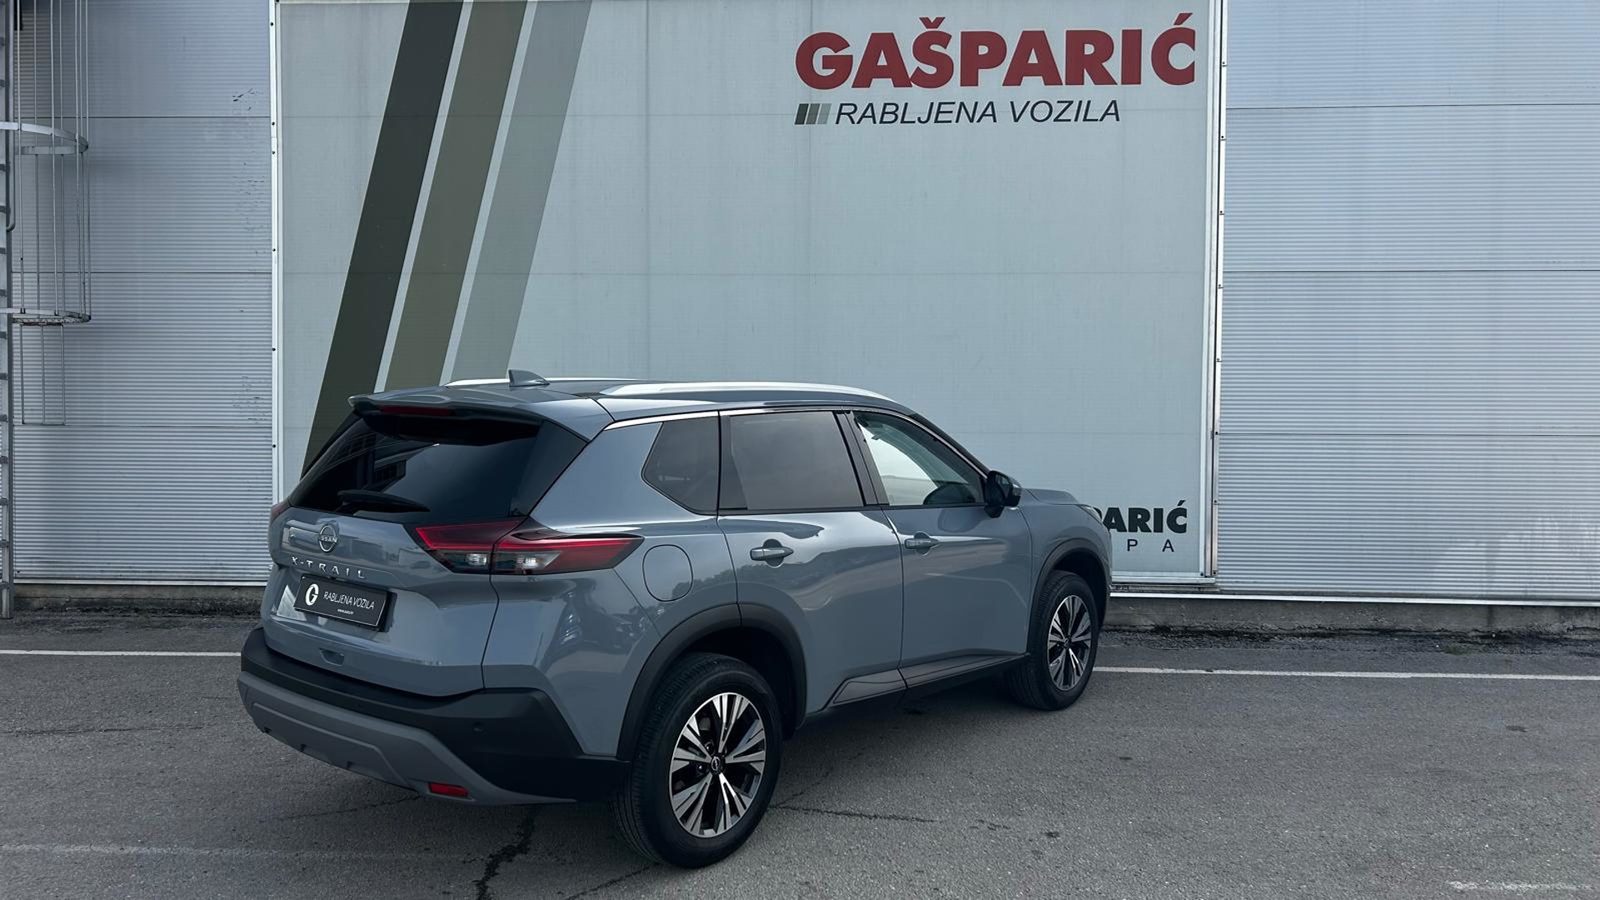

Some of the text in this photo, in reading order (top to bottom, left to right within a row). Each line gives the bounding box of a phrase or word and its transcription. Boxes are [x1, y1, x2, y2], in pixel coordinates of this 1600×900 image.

[795, 13, 1197, 90] GAŠPARIĆ
[836, 99, 1121, 125] RABLJENA VOZILA
[291, 556, 366, 579] X-TRAIL
[323, 591, 375, 610] RABLJENA VOZILA
